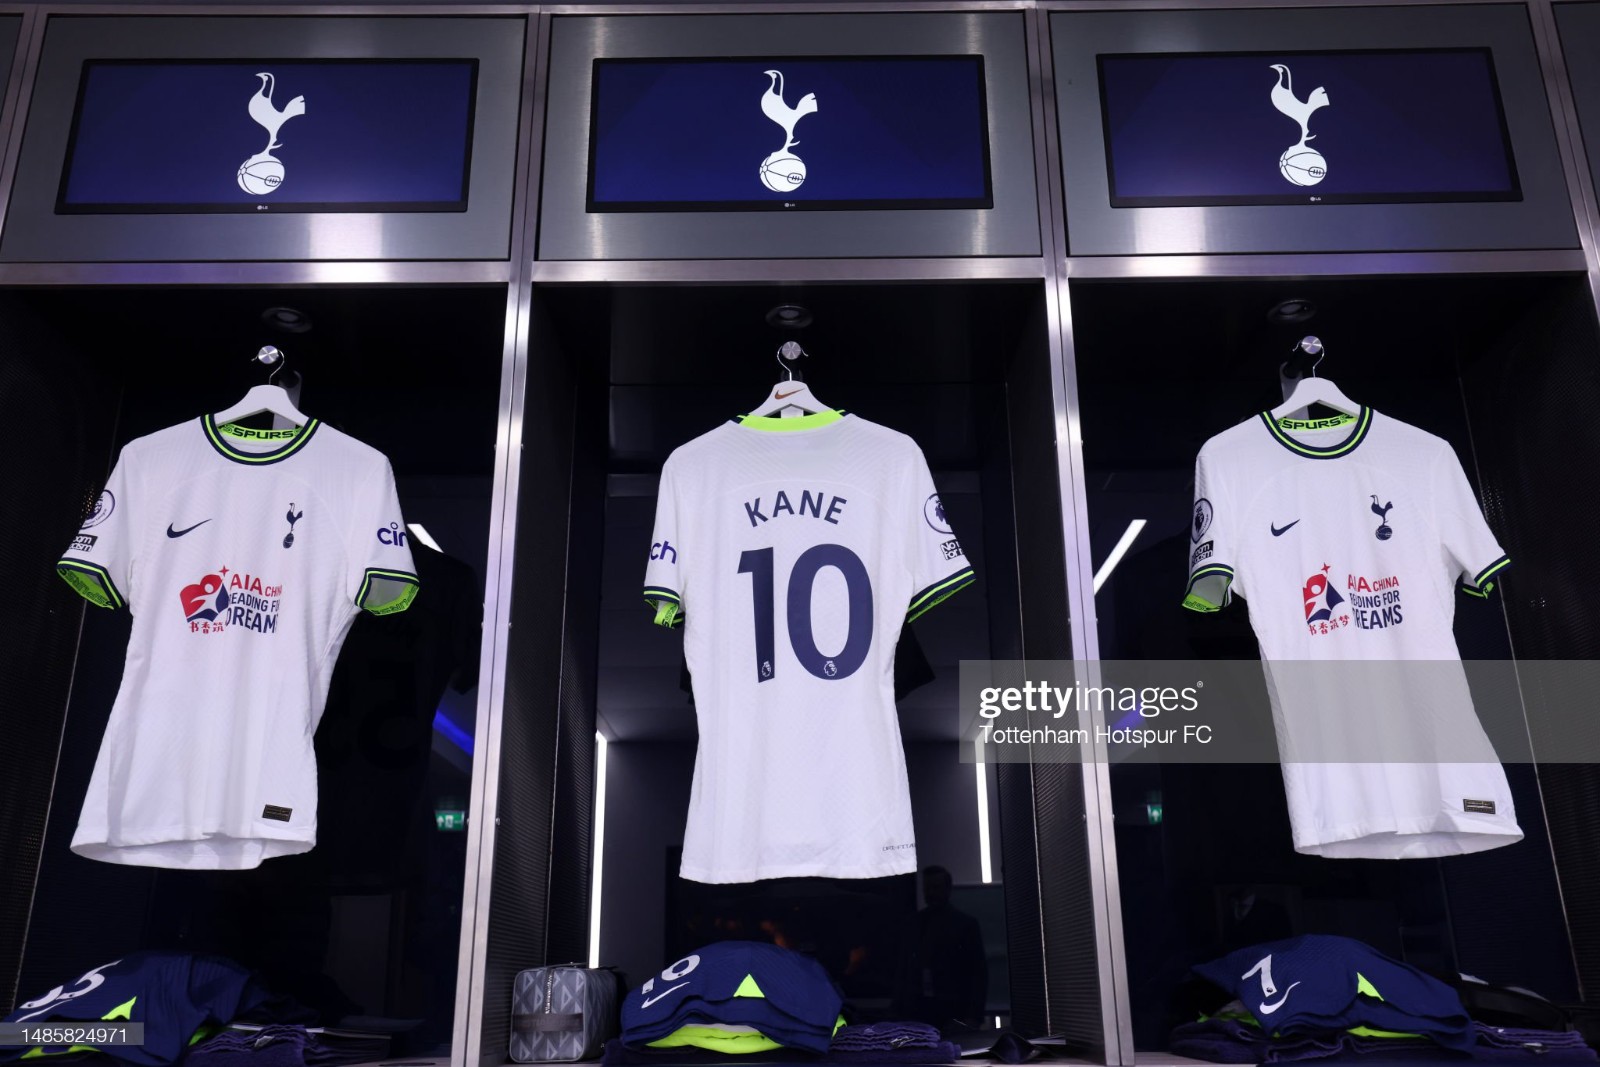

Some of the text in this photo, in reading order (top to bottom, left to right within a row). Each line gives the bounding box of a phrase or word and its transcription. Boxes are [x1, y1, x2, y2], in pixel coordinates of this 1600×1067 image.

[232, 427, 294, 439] SPURS
[1281, 417, 1341, 430] SPURS
[744, 489, 847, 528] KANE
[650, 540, 677, 565] ch
[230, 573, 263, 595] AIA
[1348, 574, 1400, 592] AIA CHINA
[1382, 590, 1401, 606] FOR
[225, 606, 279, 634] DREAM
[737, 543, 873, 684] 10
